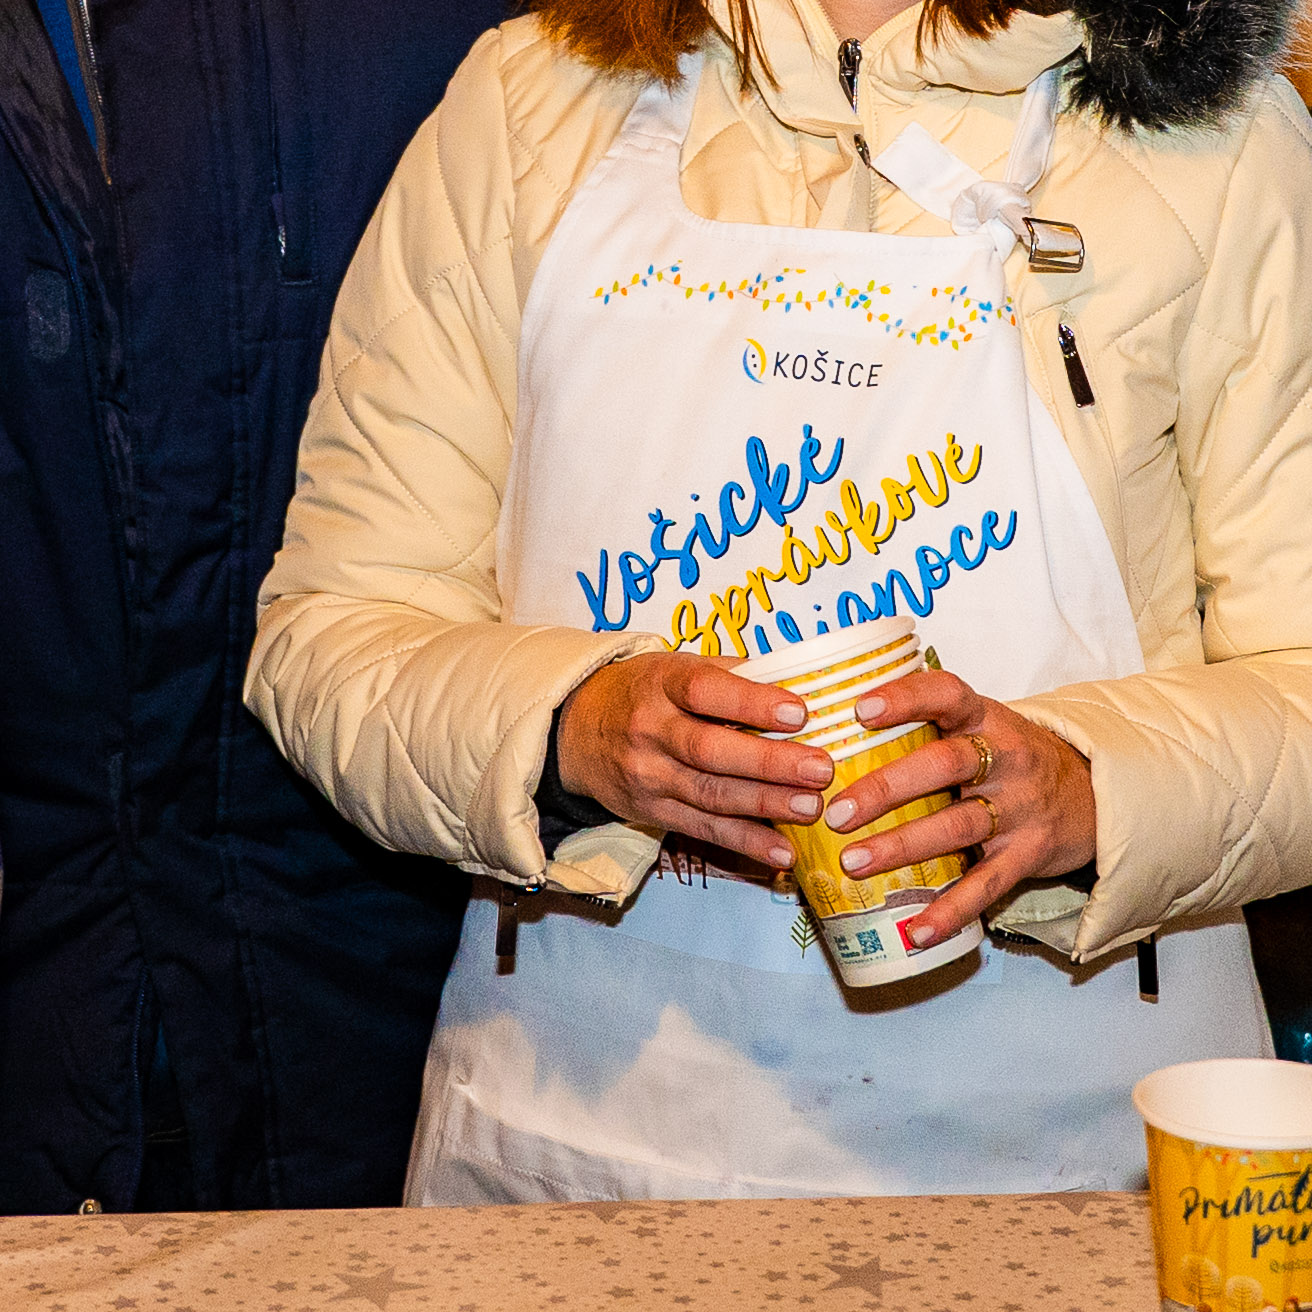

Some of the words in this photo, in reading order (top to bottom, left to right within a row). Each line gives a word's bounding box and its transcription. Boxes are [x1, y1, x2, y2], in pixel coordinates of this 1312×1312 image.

[773, 349, 884, 388] KOŠICE
[576, 423, 845, 633] Košické
[666, 433, 983, 659] zprávkové
